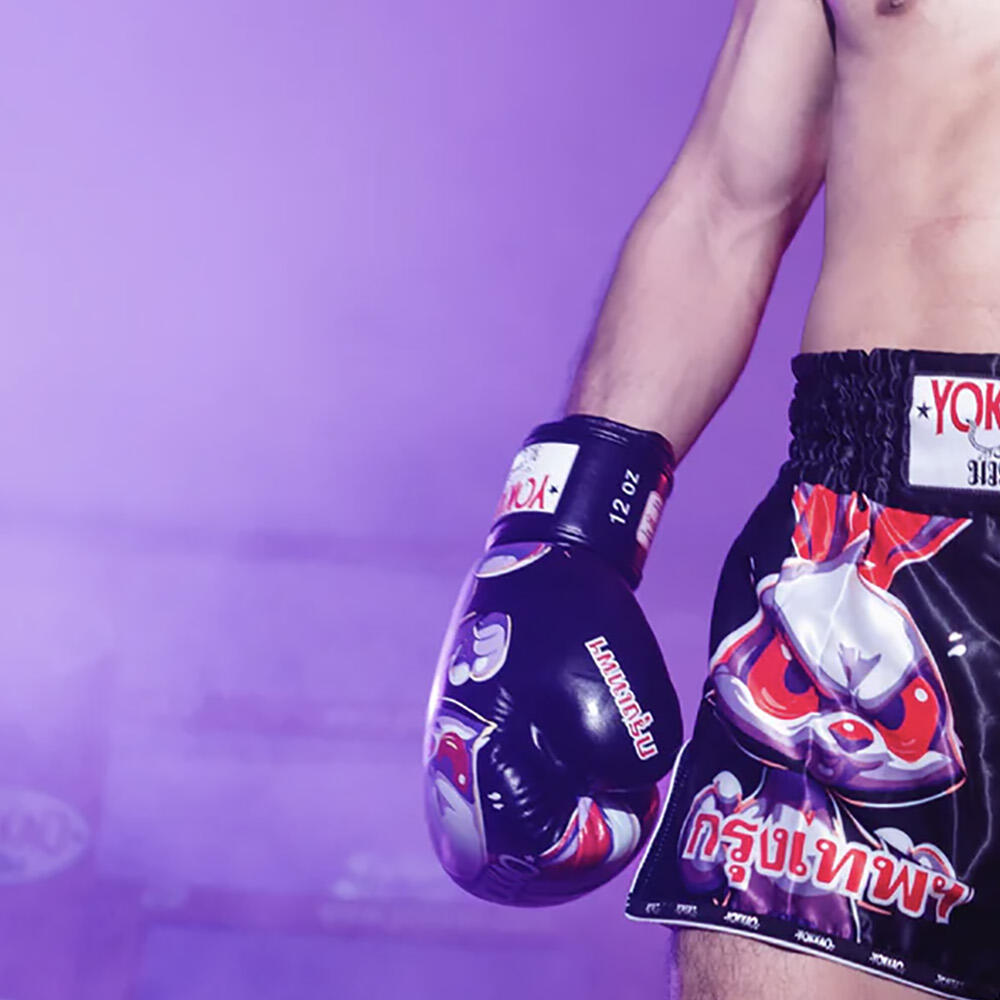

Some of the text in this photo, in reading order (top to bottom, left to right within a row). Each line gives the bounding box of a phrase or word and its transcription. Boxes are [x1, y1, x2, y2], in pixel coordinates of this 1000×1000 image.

[608, 498, 631, 525] 12
[681, 809, 972, 925] กรุงเทพฯ
